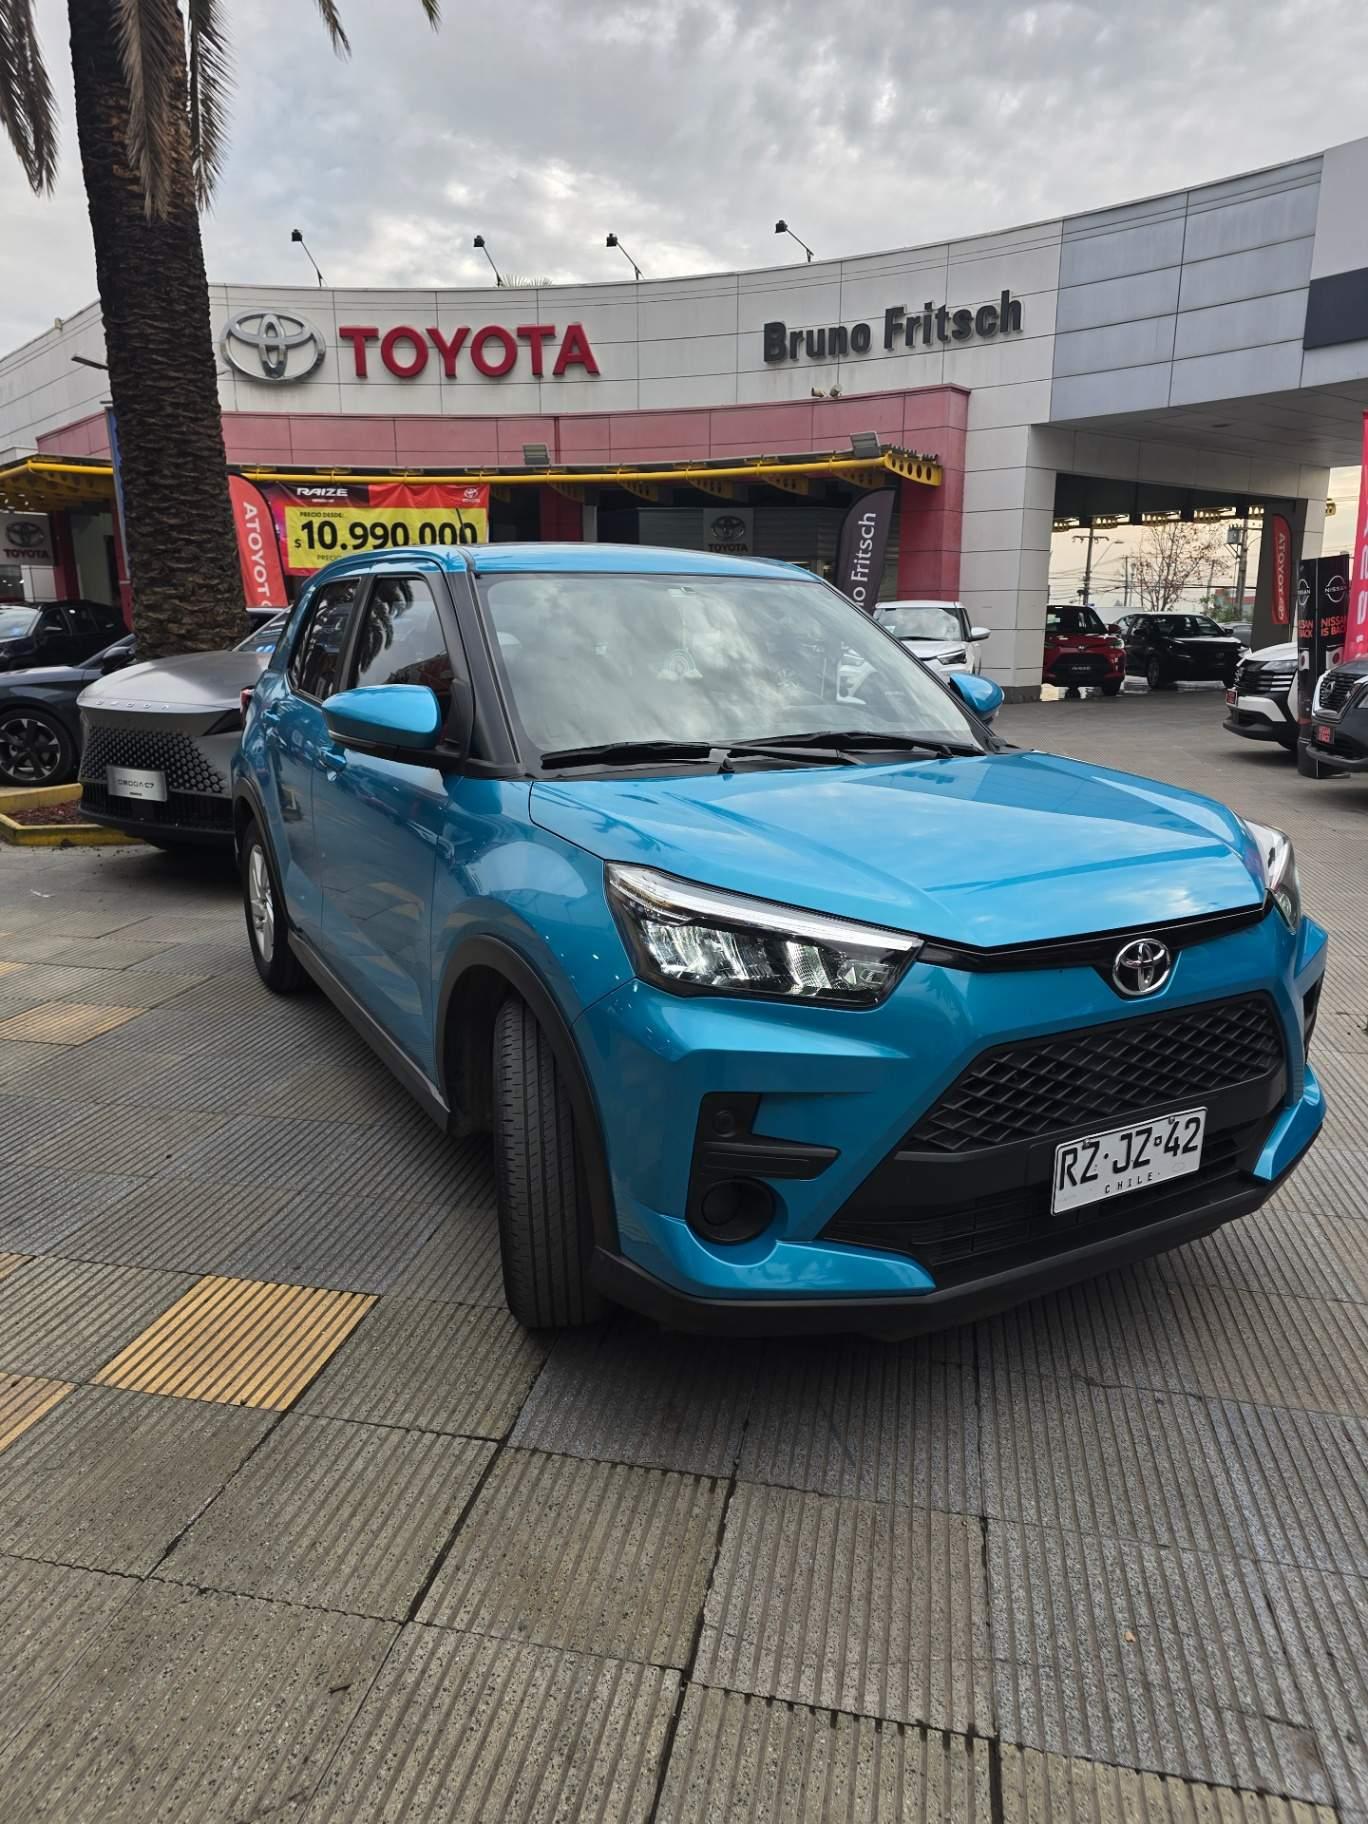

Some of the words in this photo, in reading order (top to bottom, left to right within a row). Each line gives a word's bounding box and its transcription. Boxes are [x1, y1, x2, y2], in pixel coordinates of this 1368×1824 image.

[763, 320, 872, 363] Bruno
[883, 289, 1024, 351] Fritsch
[339, 323, 600, 379] TOYOTA
[296, 487, 349, 497] RAIZE
[3, 548, 50, 559] TOYOTA
[708, 543, 749, 553] TOYOTA
[850, 512, 877, 582] Fritsch
[1104, 1171, 1154, 1194] CHILE
